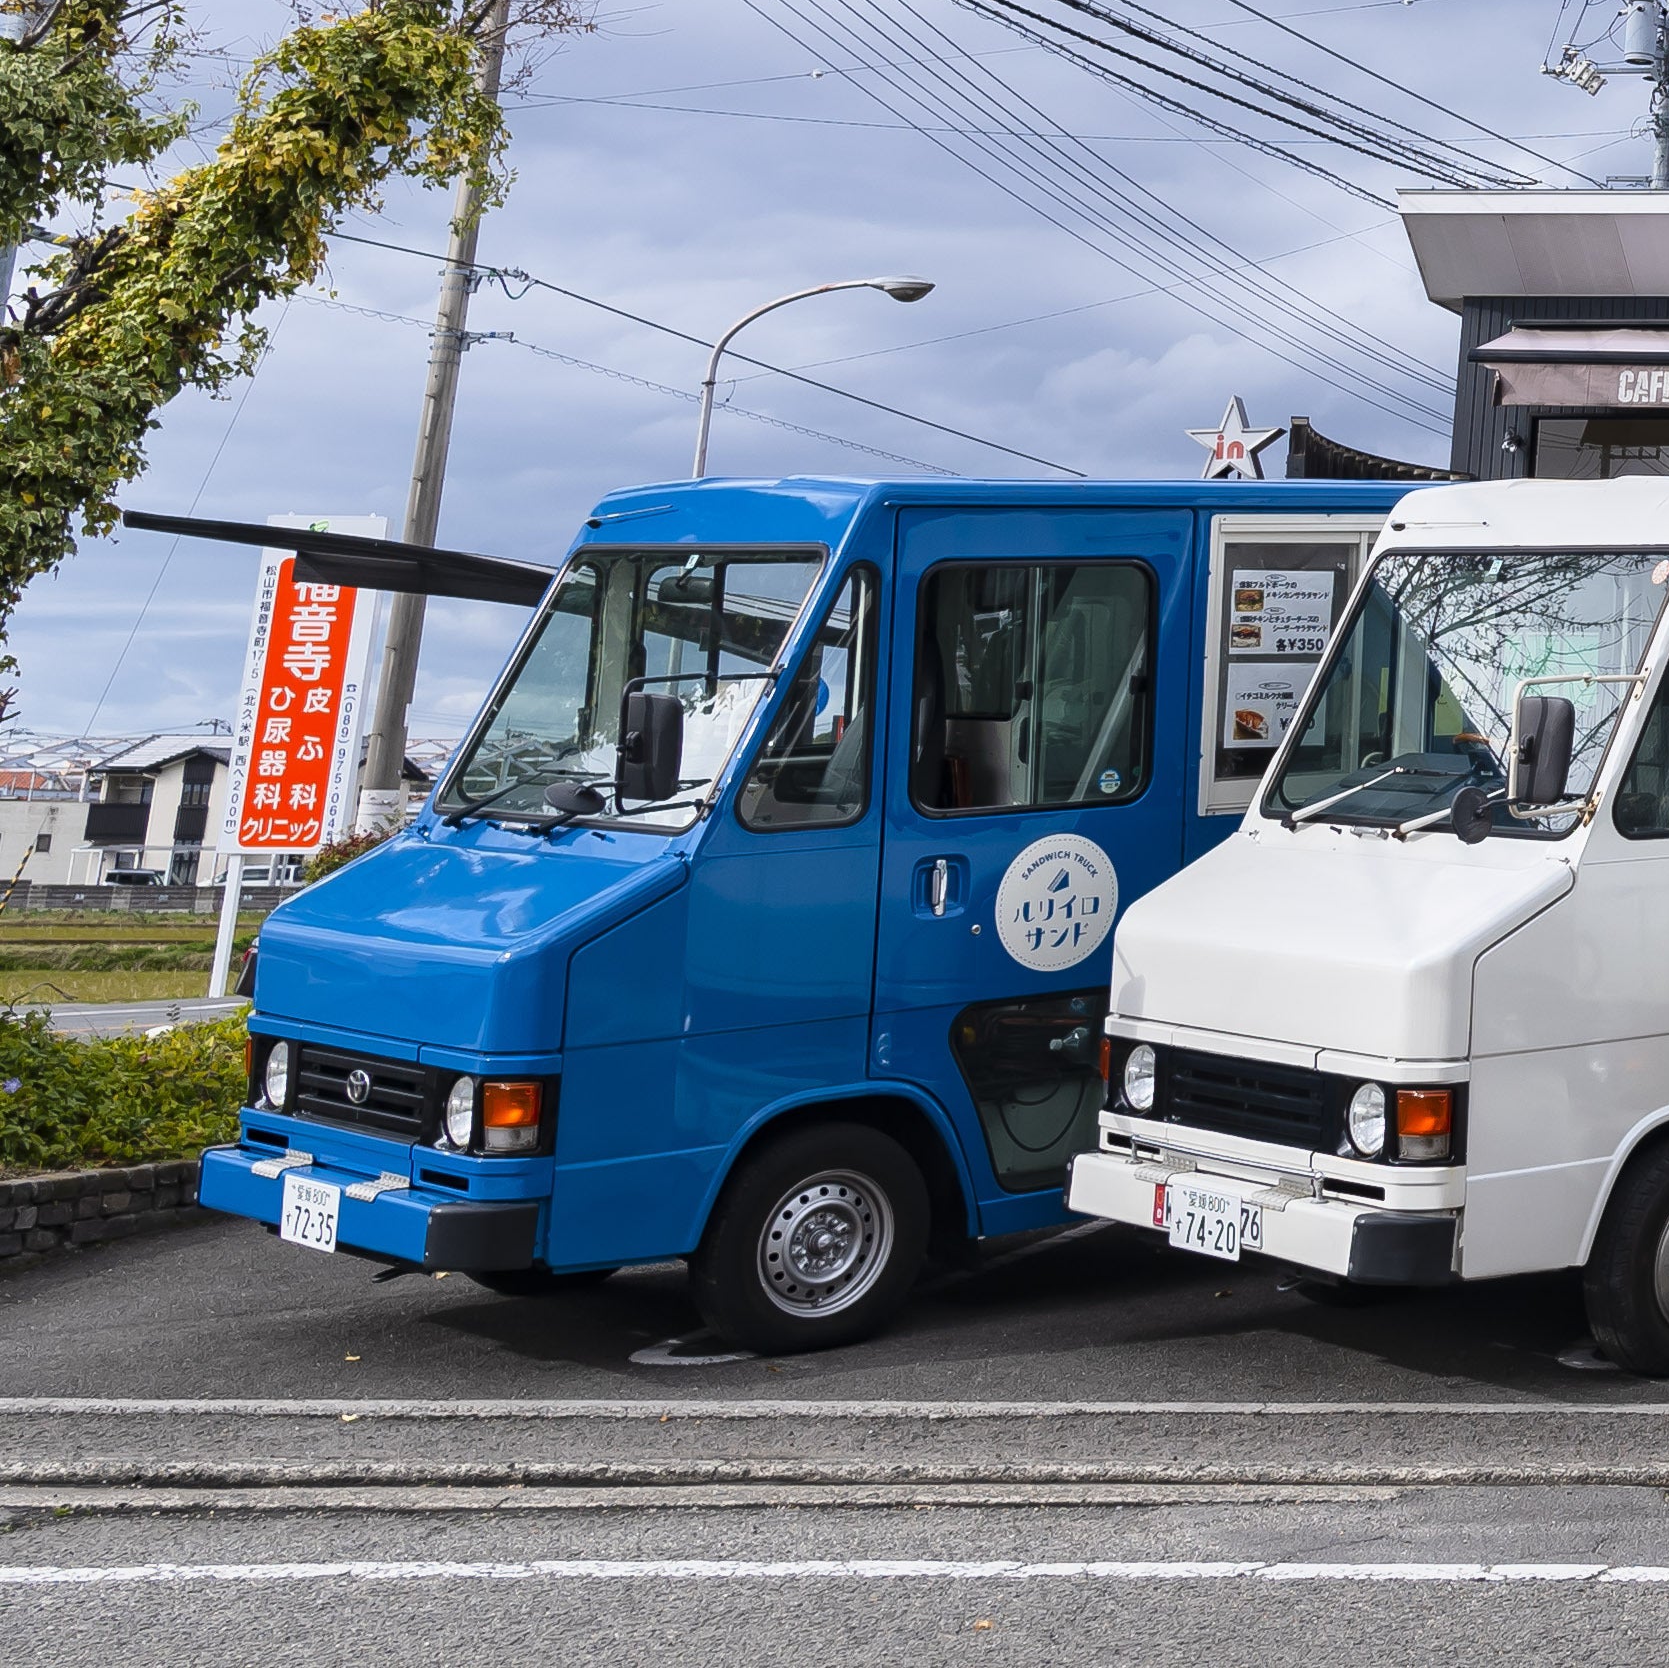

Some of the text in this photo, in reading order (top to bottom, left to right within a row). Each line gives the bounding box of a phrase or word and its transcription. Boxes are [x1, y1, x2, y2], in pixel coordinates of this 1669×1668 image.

[1215, 434, 1244, 460] in
[282, 581, 342, 681] 福音寺
[242, 817, 320, 842] クリニック
[1021, 850, 1099, 881] SANDWICH TRUCK
[1013, 894, 1100, 923] ルリイロ
[1024, 921, 1090, 951] サンド
